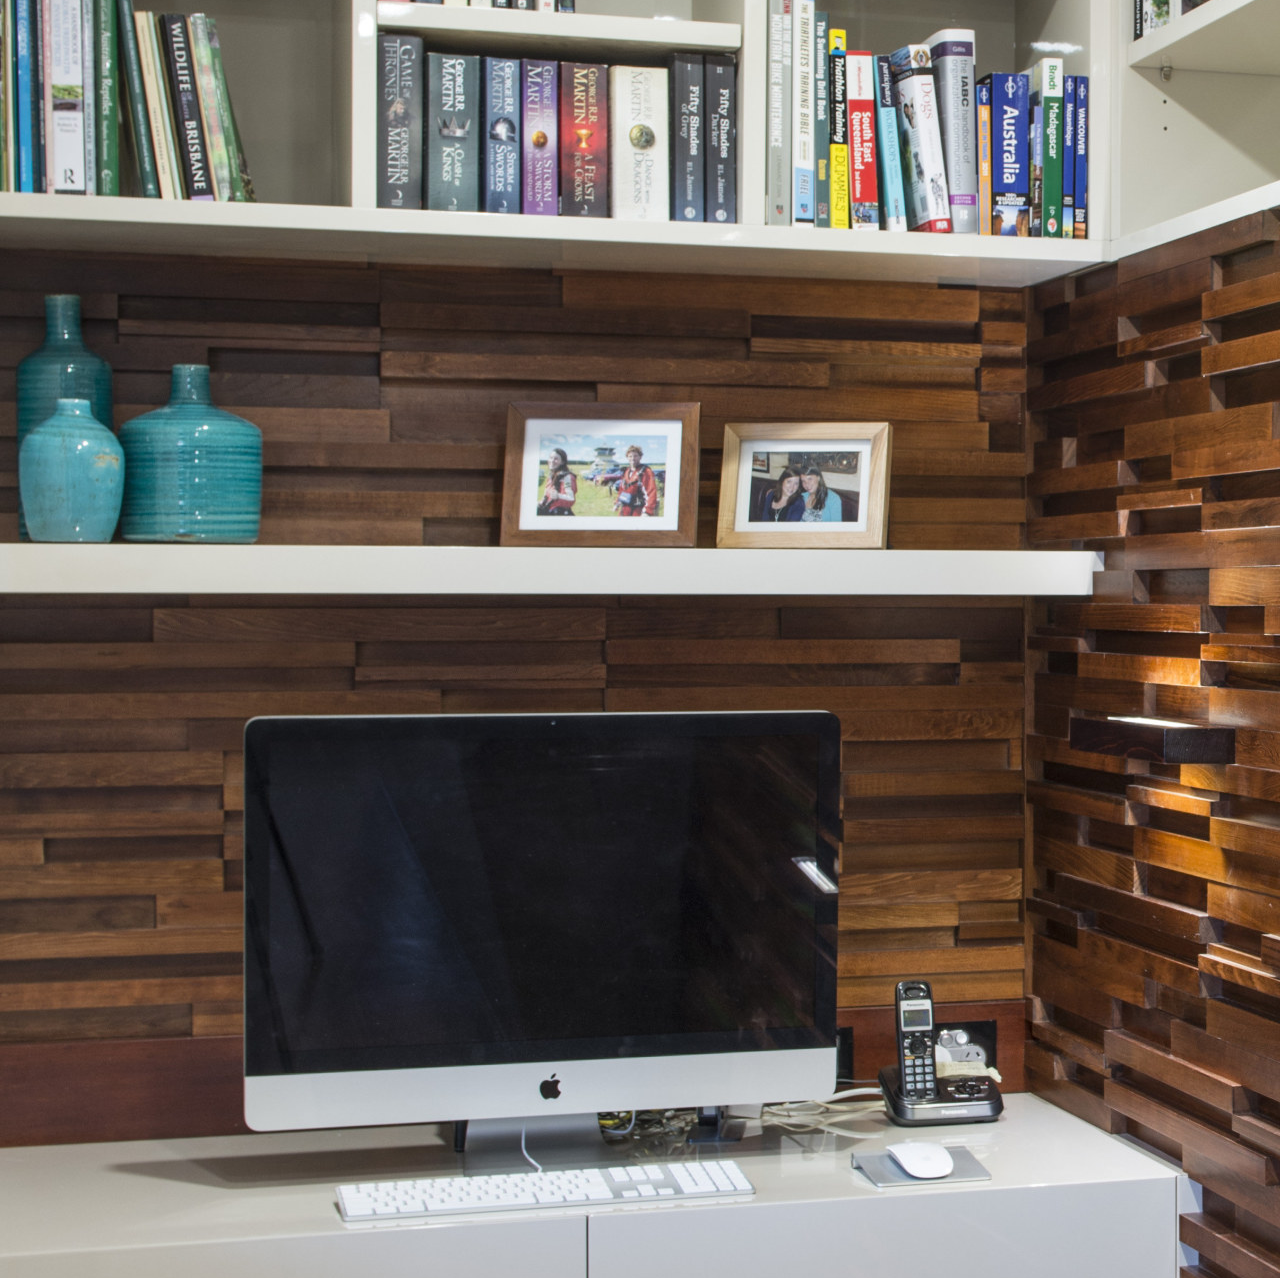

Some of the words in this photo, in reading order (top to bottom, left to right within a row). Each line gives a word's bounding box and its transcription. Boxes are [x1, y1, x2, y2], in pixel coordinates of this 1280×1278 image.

[771, 13, 782, 60] MOUNTAIN
[817, 21, 825, 36] The
[54, 40, 62, 67] SPECIES
[71, 54, 78, 65] OF
[100, 30, 111, 76] Australian
[384, 40, 398, 101] THRONES
[400, 45, 415, 87] GAME
[771, 63, 783, 83] BIKE
[816, 37, 826, 79] Swimming
[100, 78, 113, 115] Reptiles
[442, 58, 455, 111] MARTIN
[492, 61, 504, 115] MARTIN
[527, 65, 542, 128] MARTIN
[573, 68, 588, 124] MARTIN
[631, 71, 643, 122] MARTIN
[817, 80, 826, 98] Drill
[834, 57, 845, 101] Triathlon
[880, 62, 892, 106] participatory
[951, 59, 963, 121] organizational
[961, 75, 969, 107] IABC
[1048, 65, 1057, 90] Bradt
[170, 22, 192, 91] WILDLIFE
[184, 120, 206, 190] BRISBANE
[681, 103, 689, 114] of
[688, 85, 699, 113] Fifty
[718, 88, 729, 116] Fifty
[771, 85, 783, 147] MAINTENANCE
[817, 100, 826, 120] Book
[921, 81, 934, 119] Dogs
[680, 115, 688, 138] Grey
[689, 116, 699, 155] Shades
[711, 114, 719, 147] Darker
[720, 118, 729, 158] Shades
[834, 103, 846, 143] Training
[852, 111, 864, 170] Queensland
[861, 111, 872, 141] South
[885, 109, 898, 162] WORKSHOPS
[962, 109, 970, 153] handbook
[1047, 103, 1059, 159] Madagascar
[1065, 103, 1073, 146] Mozambique
[1077, 108, 1086, 155] VANCOUVER
[388, 127, 400, 184] MARTIN
[443, 147, 454, 181] KINGS
[574, 152, 582, 168] FOR
[863, 142, 873, 162] East
[953, 123, 962, 191] communication
[963, 154, 971, 164] of
[1003, 105, 1019, 184] Australia
[495, 144, 506, 191] SWORDS
[574, 168, 584, 202] CROWS
[584, 165, 596, 202] FEAST
[633, 152, 644, 204] DRAGONS
[800, 174, 809, 196] FRIEL
[835, 154, 846, 211] DUMMIES
